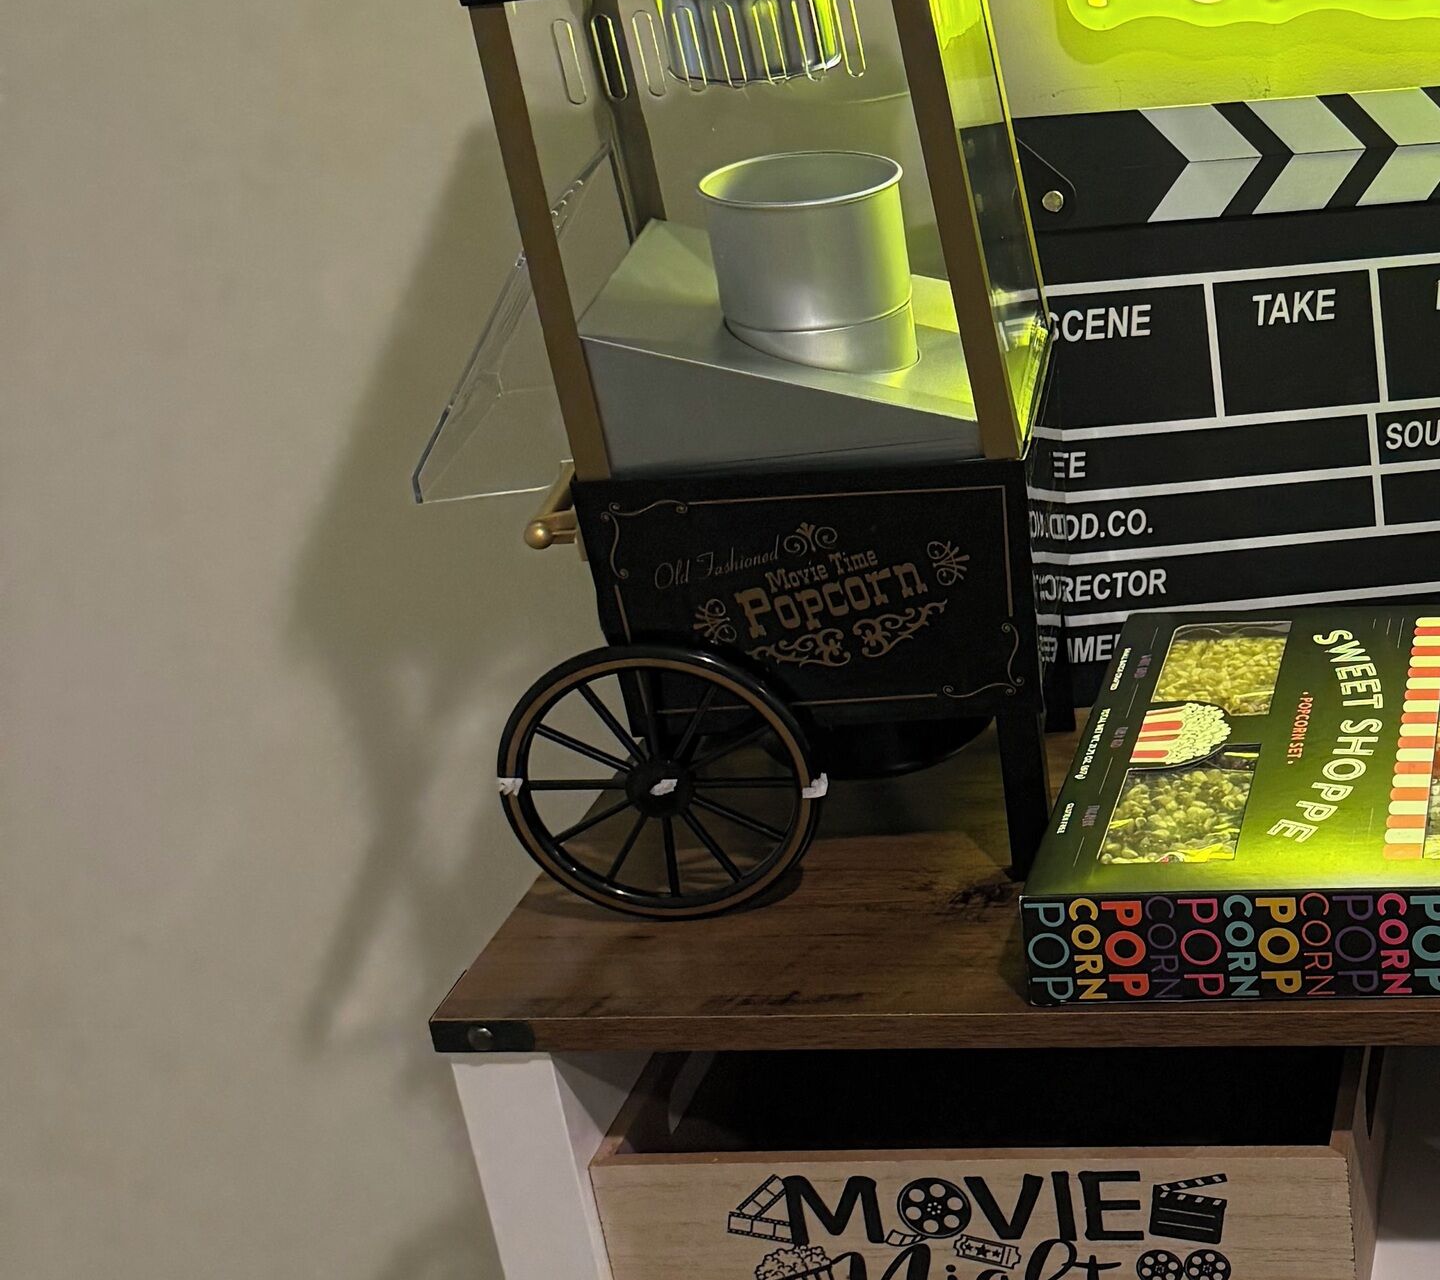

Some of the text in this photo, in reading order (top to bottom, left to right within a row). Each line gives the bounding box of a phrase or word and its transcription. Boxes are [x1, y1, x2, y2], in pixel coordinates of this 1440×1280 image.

[1252, 288, 1337, 327] TAKE
[654, 534, 780, 590] Old Fashioned
[734, 563, 928, 639] Popcorn
[765, 549, 879, 594] Movie Time
[1058, 568, 1167, 603] RECTOR
[1266, 629, 1384, 844] SWEET SHOPPE
[1287, 696, 1314, 759] POPCORN SET
[1024, 902, 1074, 1000] POP
[1069, 897, 1108, 1000] CORN
[1101, 900, 1150, 996] POP
[1145, 896, 1182, 998] CORN
[1177, 898, 1225, 996] POP
[1223, 895, 1260, 996] CORN
[1255, 897, 1302, 994] POP
[1300, 893, 1335, 995] CORN
[1332, 895, 1379, 992] POP
[1377, 893, 1412, 994] CORN
[783, 1170, 1144, 1246] MOVIE
